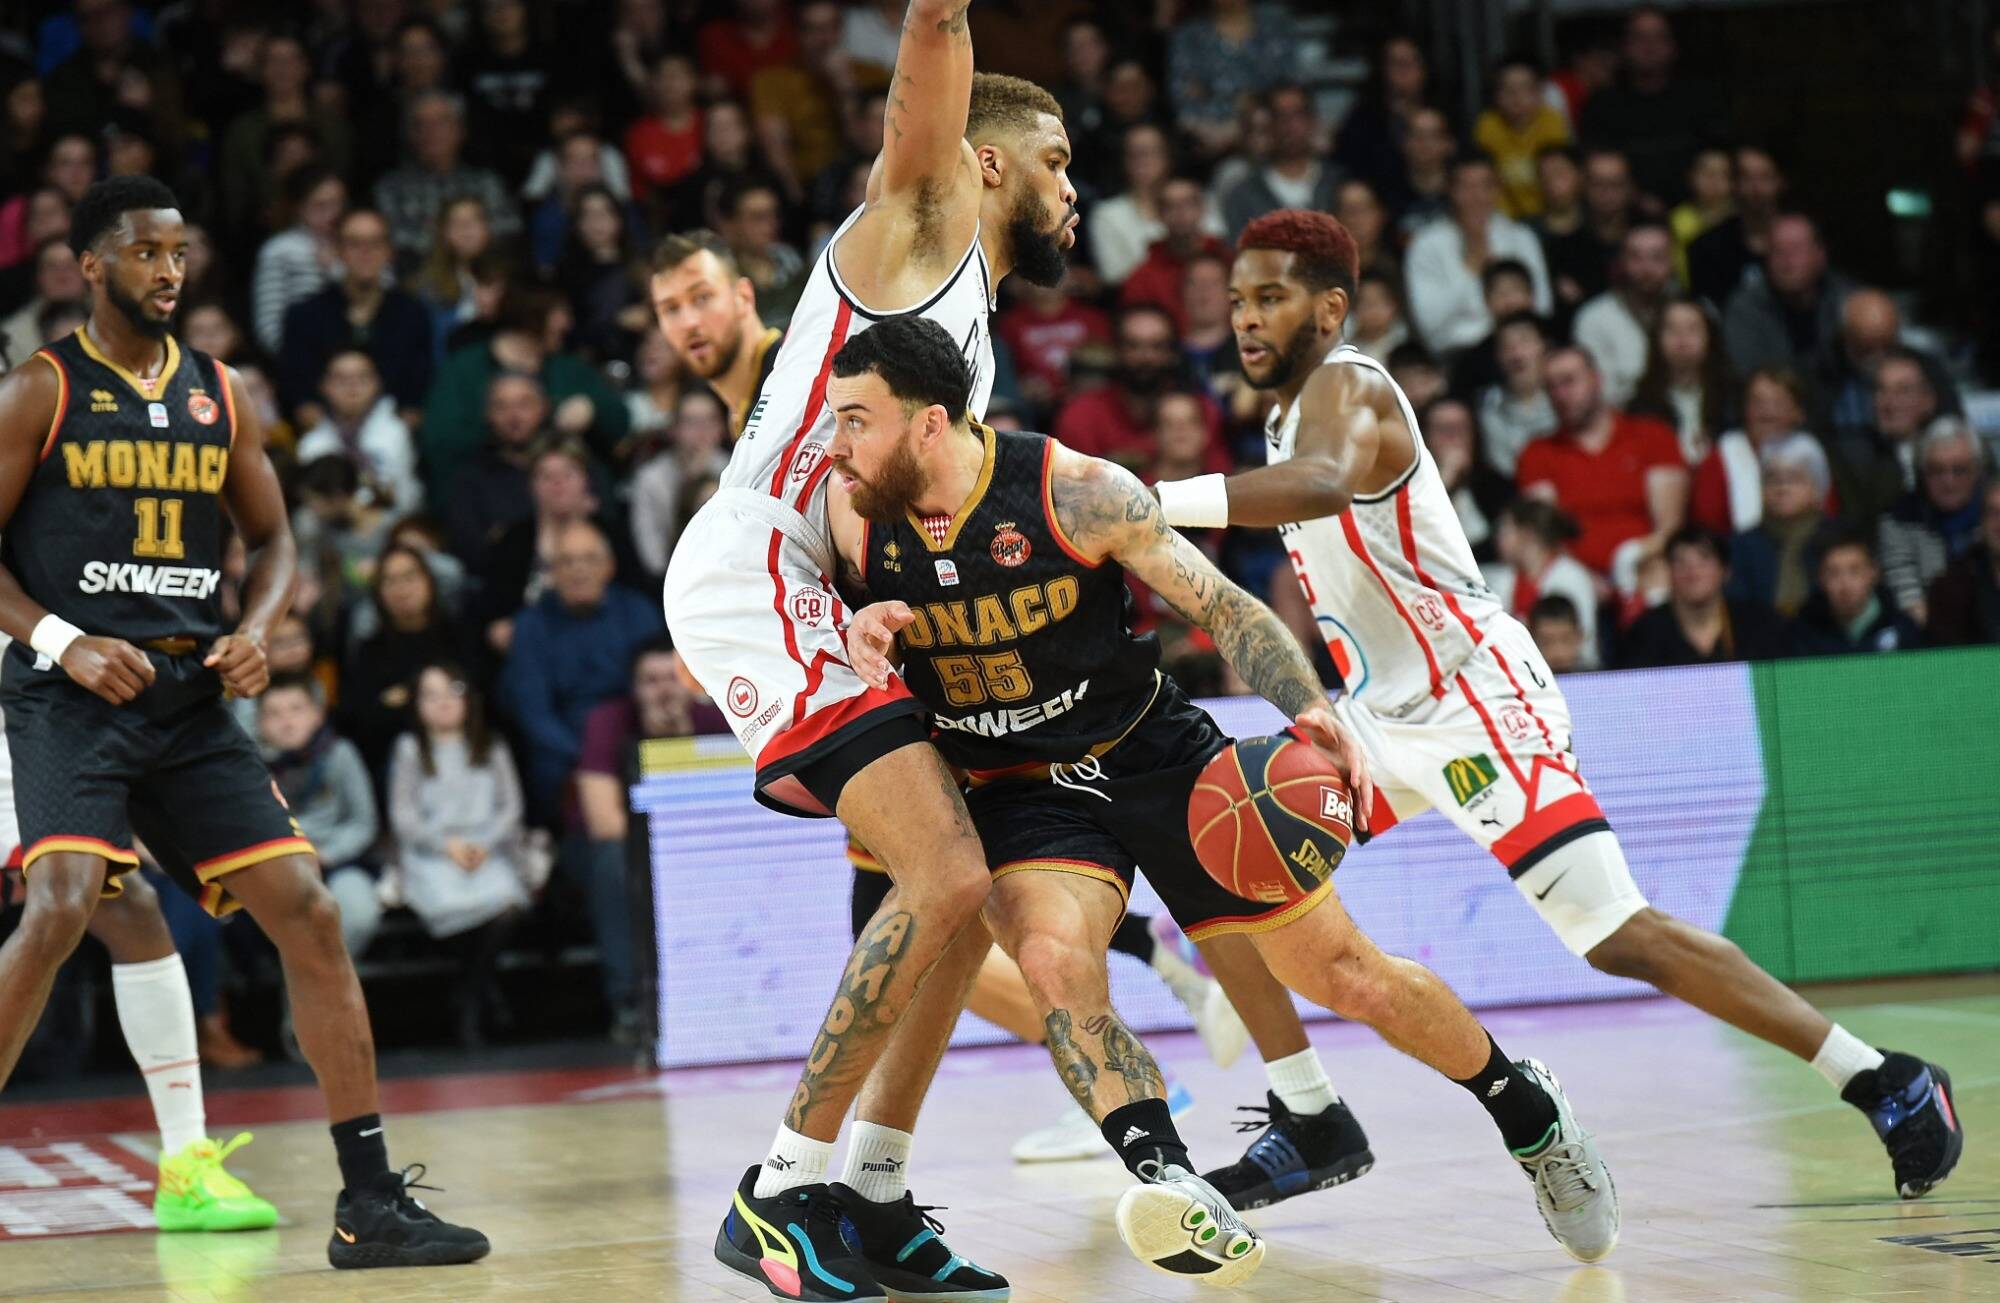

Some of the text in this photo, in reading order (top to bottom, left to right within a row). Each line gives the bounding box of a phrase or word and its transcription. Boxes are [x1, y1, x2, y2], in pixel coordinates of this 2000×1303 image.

[133, 498, 184, 559] 11
[902, 576, 1079, 649] ONACO
[930, 649, 1034, 707] 55
[861, 1161, 897, 1173] PUMA
